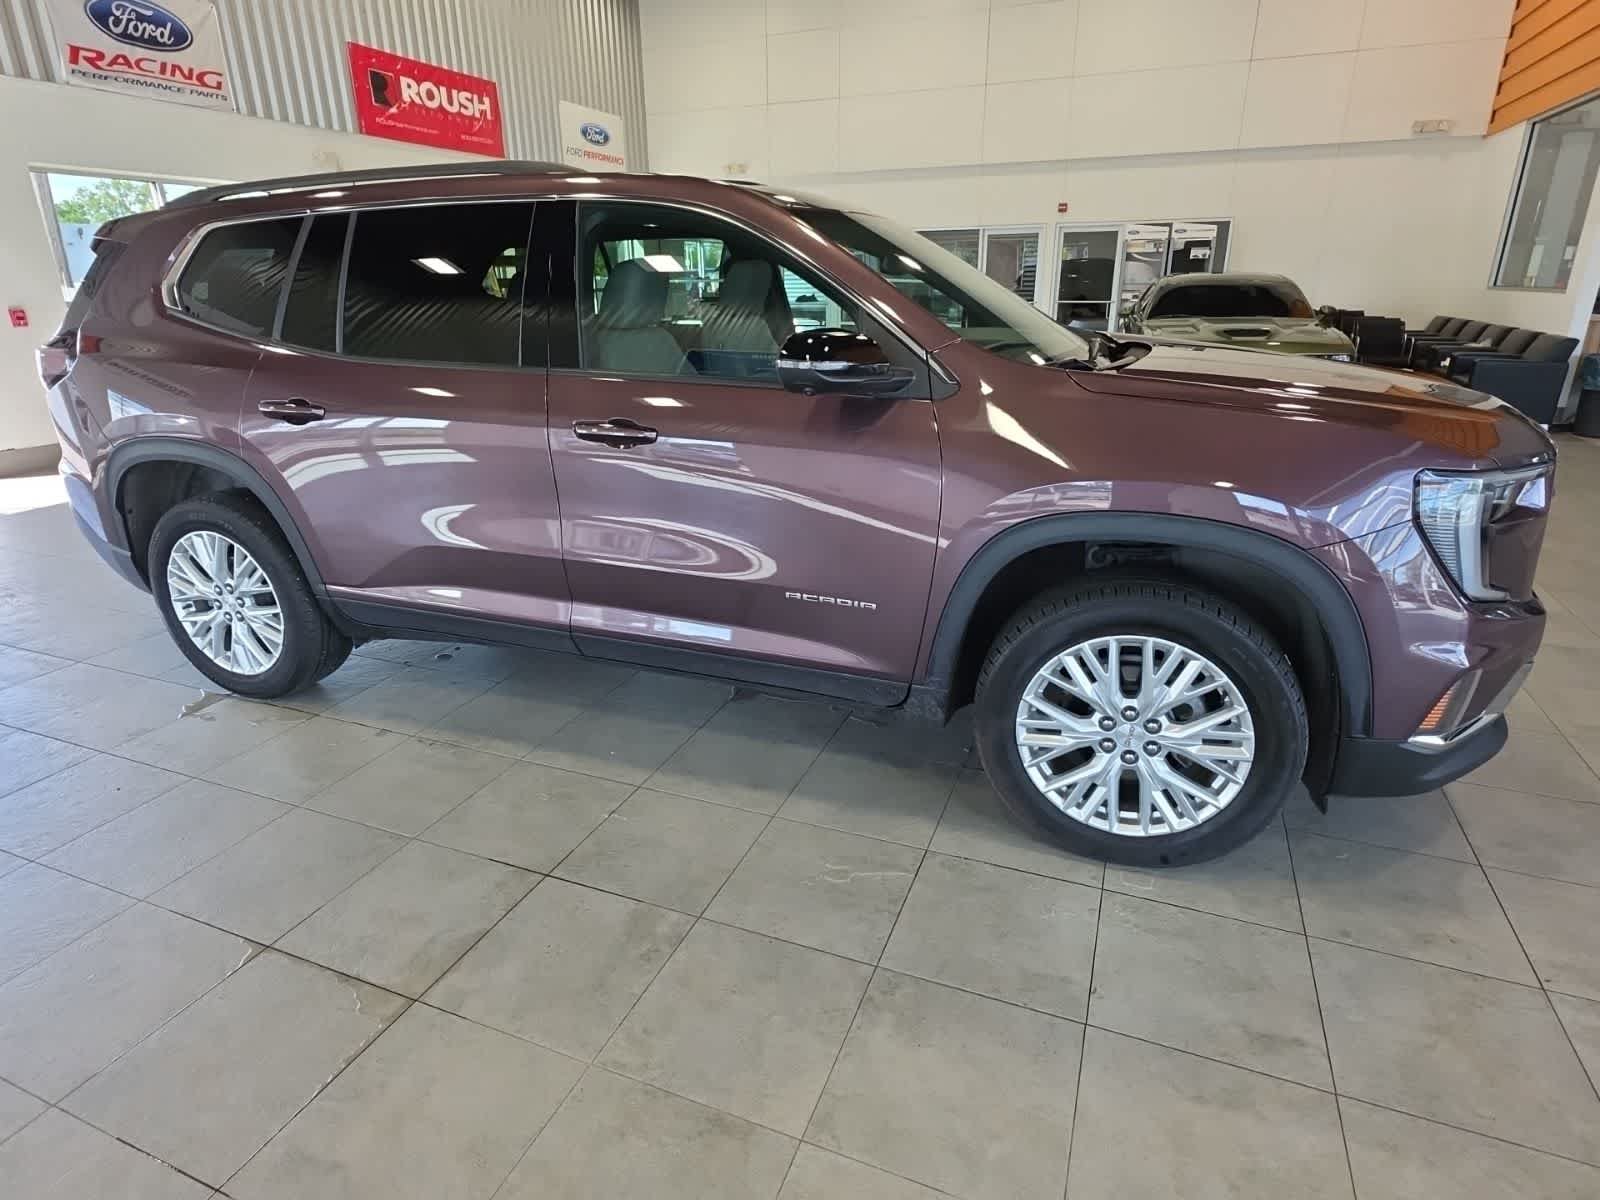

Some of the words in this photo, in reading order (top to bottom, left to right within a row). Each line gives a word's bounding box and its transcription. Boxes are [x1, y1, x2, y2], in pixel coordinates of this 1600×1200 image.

[108, 0, 174, 45] Ford
[67, 43, 223, 91] RACING
[71, 68, 186, 94] PERFORMANCE
[189, 89, 228, 102] PARTS
[400, 76, 492, 121] ROUSH
[586, 126, 605, 144] Ford
[785, 591, 877, 610] ACADIA
